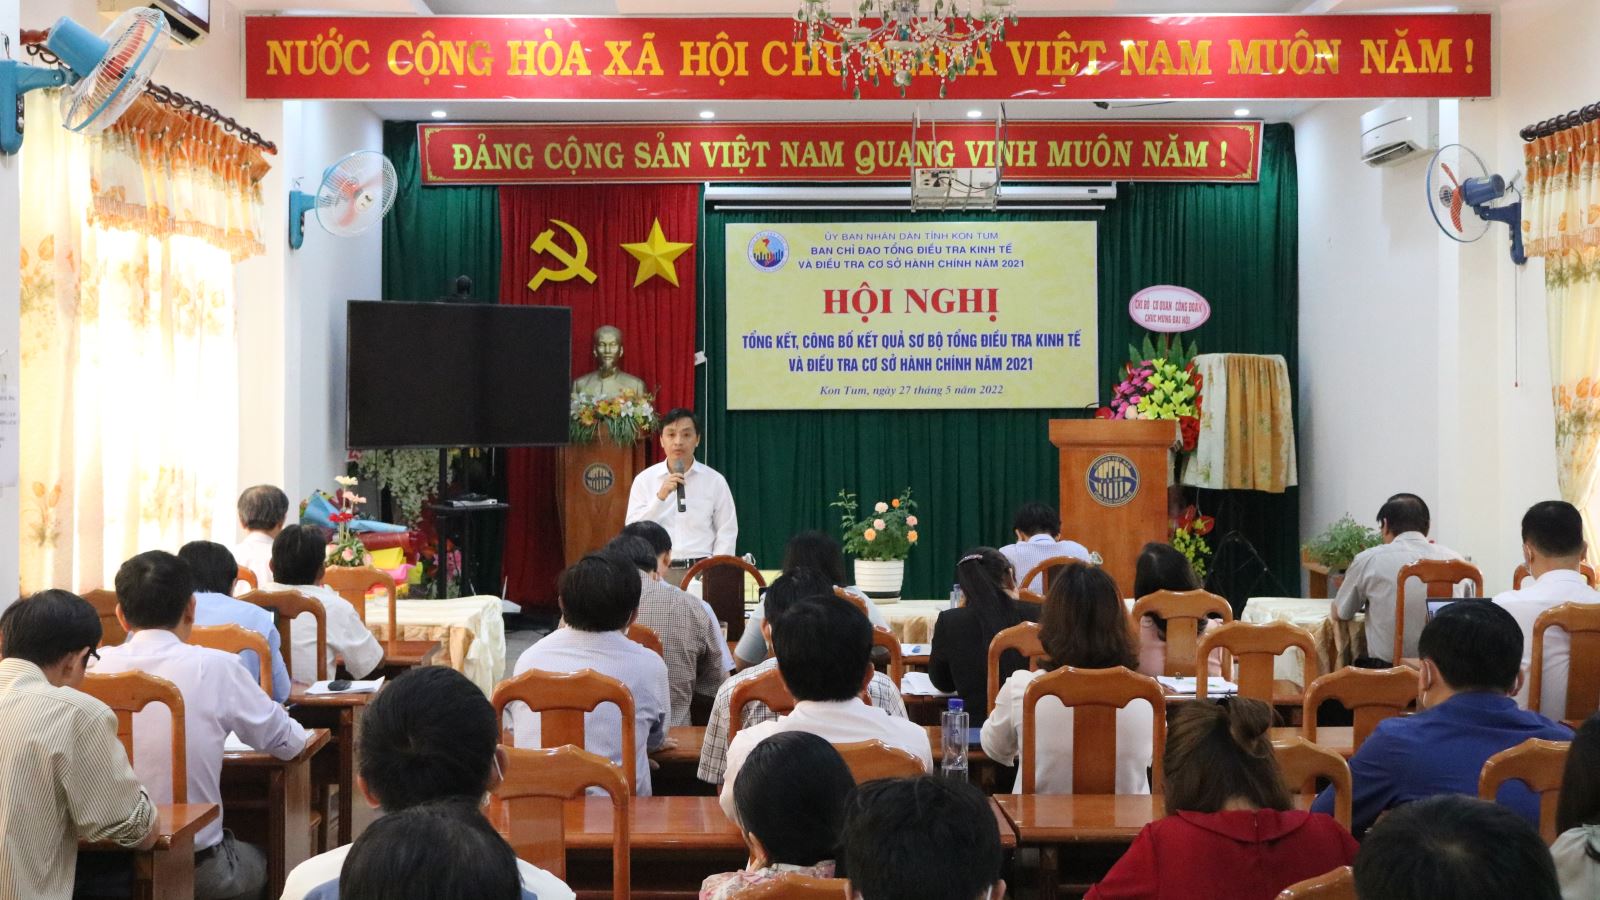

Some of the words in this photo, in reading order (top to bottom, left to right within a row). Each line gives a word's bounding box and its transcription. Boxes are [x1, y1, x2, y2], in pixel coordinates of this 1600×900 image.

[266, 27, 370, 76] NƯỚC
[387, 30, 495, 86] CỘNG
[507, 28, 592, 76] HÒA
[603, 32, 664, 76] XÃ
[680, 31, 749, 86] HỘI
[1006, 30, 1107, 84] VIỆT
[1120, 40, 1212, 75] NAM
[1229, 28, 1341, 75] MUÔN
[1361, 28, 1453, 75] NĂM
[1464, 41, 1475, 75] !
[452, 133, 534, 170] ĐẢNG
[544, 135, 624, 176] CỘNG
[634, 131, 692, 168] SẢN
[700, 134, 771, 174] VIỆT
[780, 141, 844, 167] NAM
[855, 140, 955, 175] QUANG
[965, 141, 1038, 168] VINH
[1047, 133, 1134, 168] MUÔN
[1142, 133, 1209, 168] NĂM
[1219, 141, 1228, 168] !
[841, 233, 863, 241] BAN
[866, 231, 896, 241] NHÂN
[951, 232, 974, 240] KON
[977, 232, 999, 240] TUM
[810, 246, 833, 256] BAN
[884, 242, 914, 255] TỔNG
[946, 246, 967, 255] TRA
[969, 245, 996, 254] KINH
[999, 242, 1013, 254] TẾ
[798, 259, 813, 269] VÀ
[844, 260, 865, 269] TRA
[867, 259, 884, 269] CƠ
[886, 257, 902, 269] SỞ
[904, 258, 935, 268] HÀNH
[937, 258, 972, 268] CHÍNH
[975, 258, 999, 268] NĂM
[1001, 259, 1025, 268] 2021
[823, 281, 893, 323] HỘI
[904, 288, 999, 322] NGHỊ
[742, 330, 773, 349] TỔNG
[776, 331, 799, 350] KẾT,
[802, 332, 835, 349] CÔNG
[838, 330, 854, 348] BỐ
[857, 330, 878, 348] KẾT
[881, 330, 905, 349] QUẢ
[908, 333, 925, 348] SƠ
[927, 331, 944, 350] BỘ
[947, 329, 977, 348] TỔNG
[980, 329, 1007, 348] ĐIỀU
[1011, 333, 1032, 348] TRA
[1036, 333, 1064, 347] KINH
[1067, 329, 1082, 347] TẾ
[789, 356, 804, 372] VÀ
[807, 353, 834, 372] ĐIỀU
[837, 358, 858, 372] TRA
[862, 356, 878, 372] CƠ
[881, 353, 897, 371] SỞ
[900, 355, 932, 371] HÀNH
[935, 354, 971, 371] CHÍNH
[975, 354, 1003, 371] NĂM
[1006, 357, 1034, 371] 2021
[820, 385, 840, 395] Kon
[844, 385, 870, 397] Tum,
[873, 386, 897, 397] ngày
[899, 385, 911, 395] 27
[913, 384, 943, 397] tháng
[945, 385, 952, 394] 5
[954, 385, 976, 394] năm
[979, 385, 1004, 394] 2022
